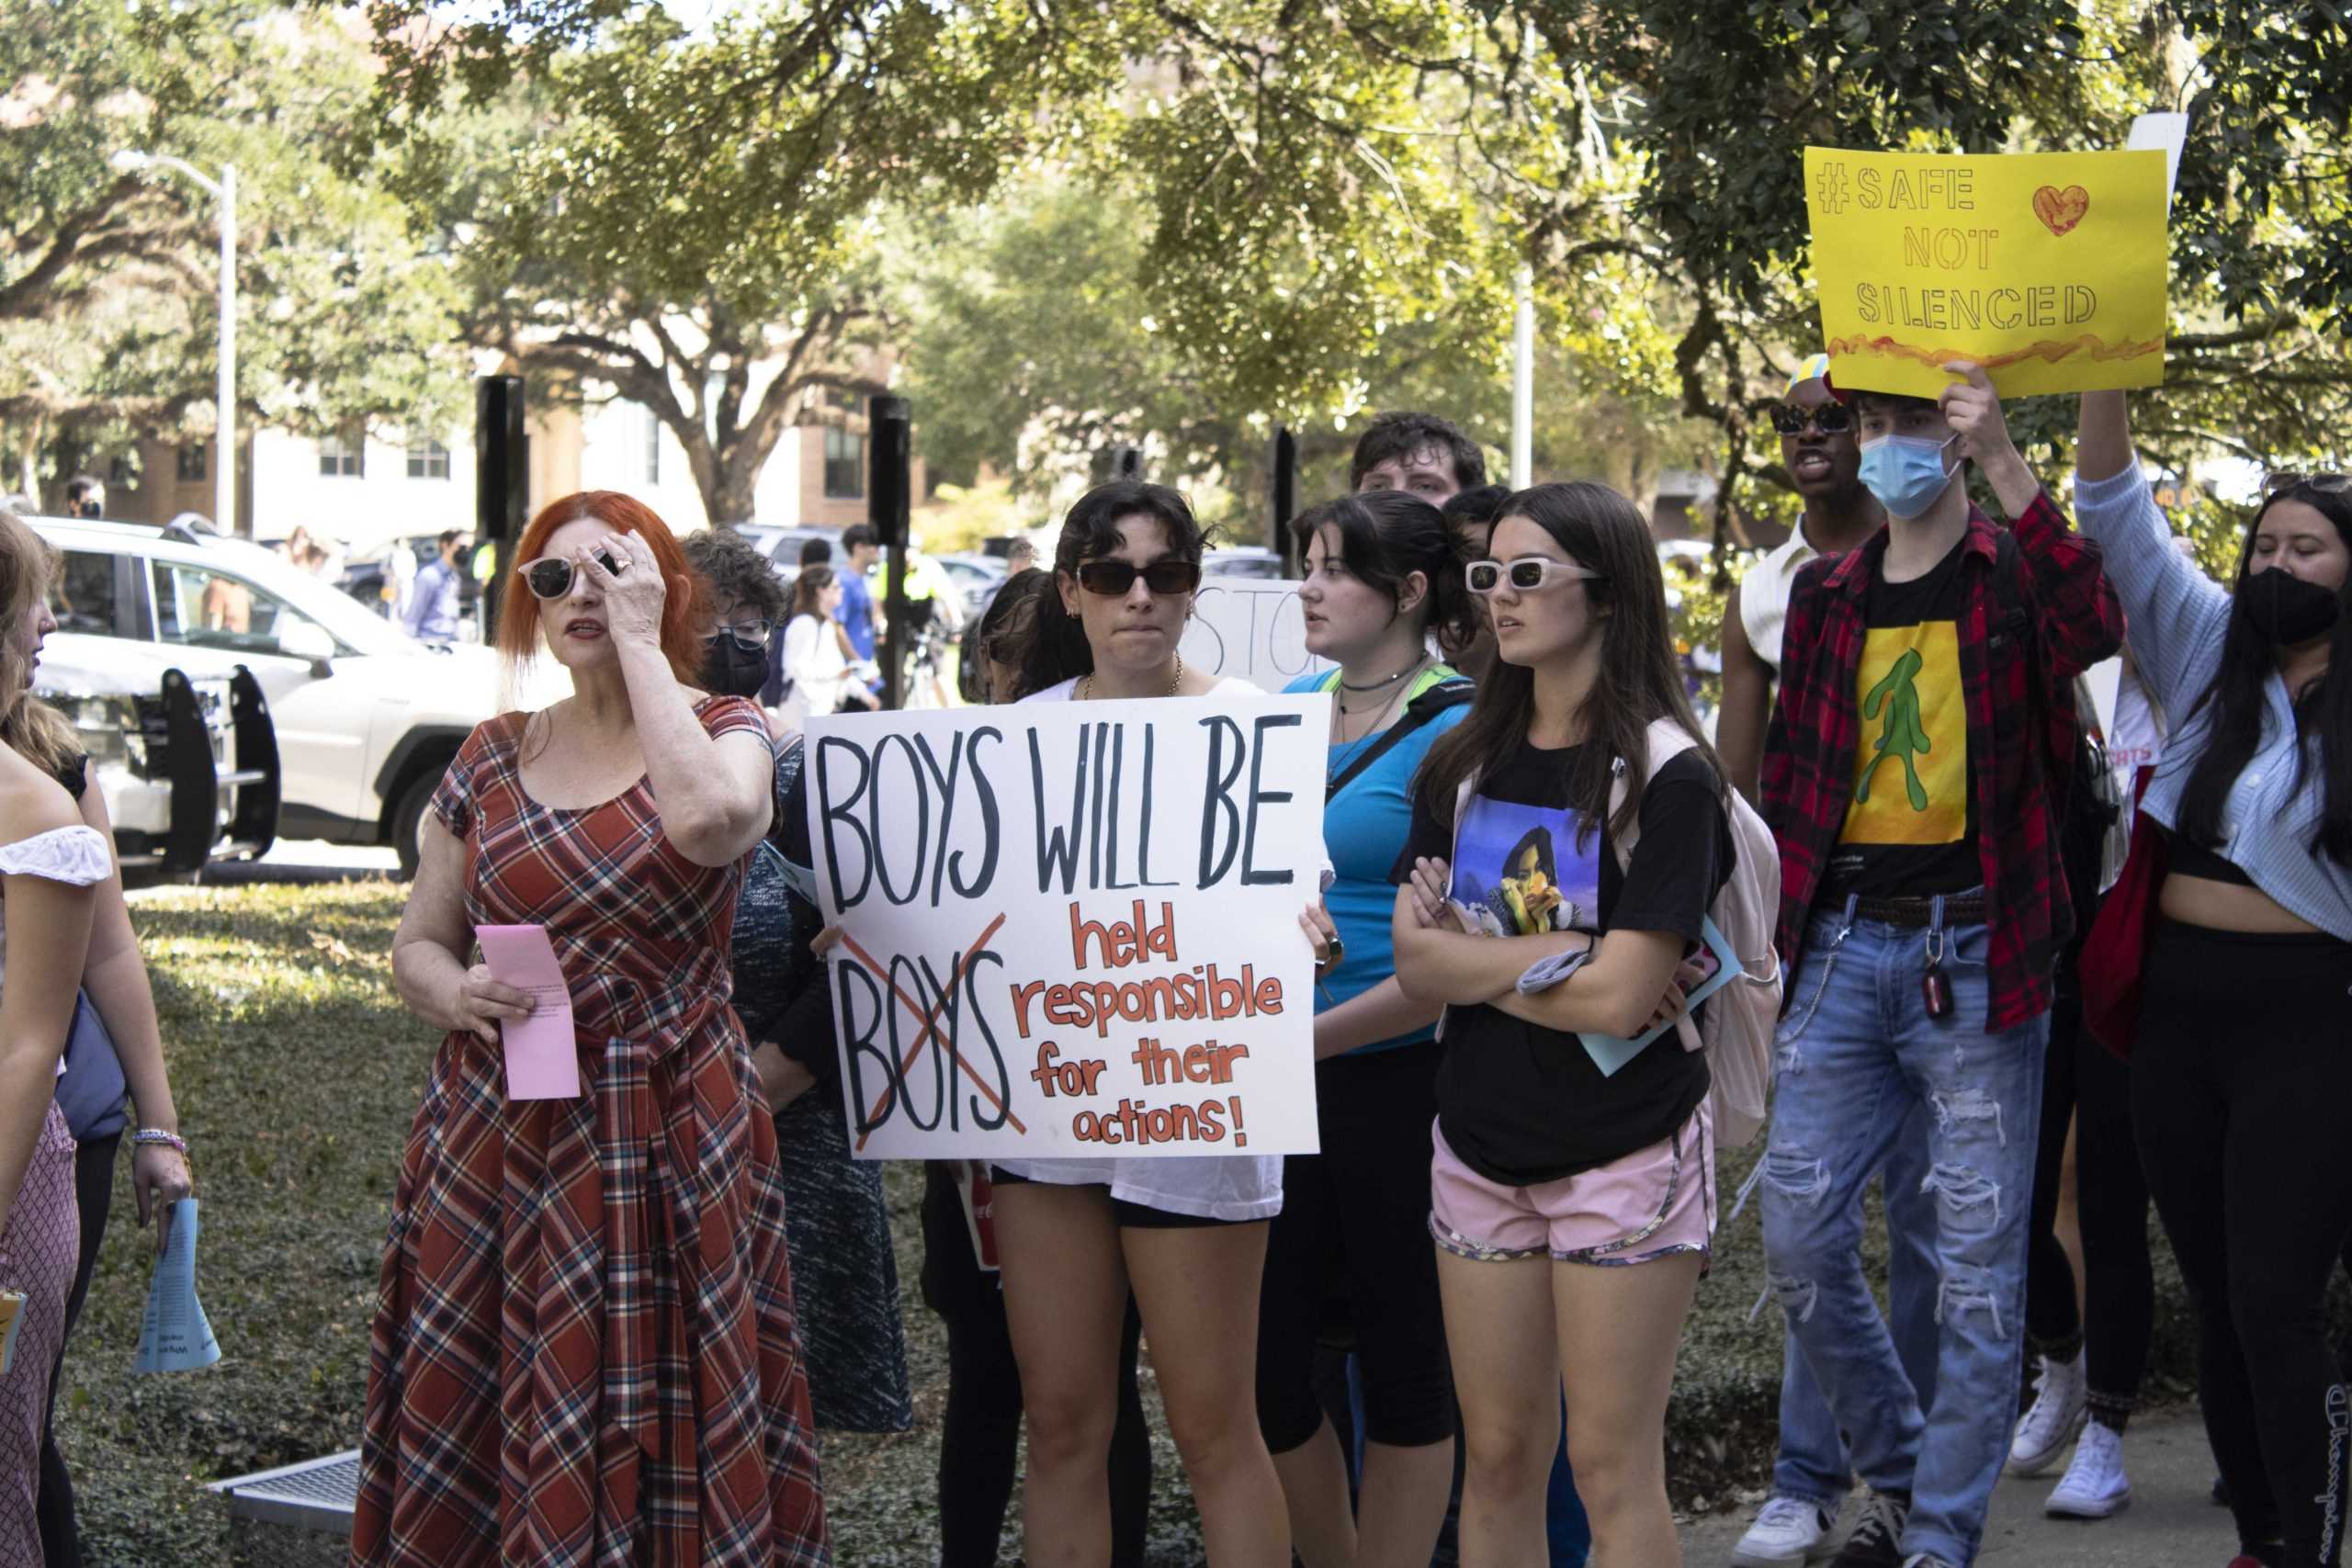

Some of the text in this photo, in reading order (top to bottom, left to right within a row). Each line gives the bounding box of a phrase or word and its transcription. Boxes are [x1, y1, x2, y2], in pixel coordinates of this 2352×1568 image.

[1815, 161, 1974, 214] #SAFE
[1903, 226, 1999, 270] NOT
[1856, 281, 2097, 331] SILENCED
[1193, 586, 1317, 676] STO
[816, 714, 1303, 915] BOYS WILL BE
[1070, 899, 1178, 970] held
[1010, 963, 1283, 1039] responsible
[838, 950, 1011, 1135] BOYS
[1031, 1038, 1250, 1099] for their
[1072, 1096, 1248, 1147] actions!
[2313, 1383, 2350, 1565] Champion
